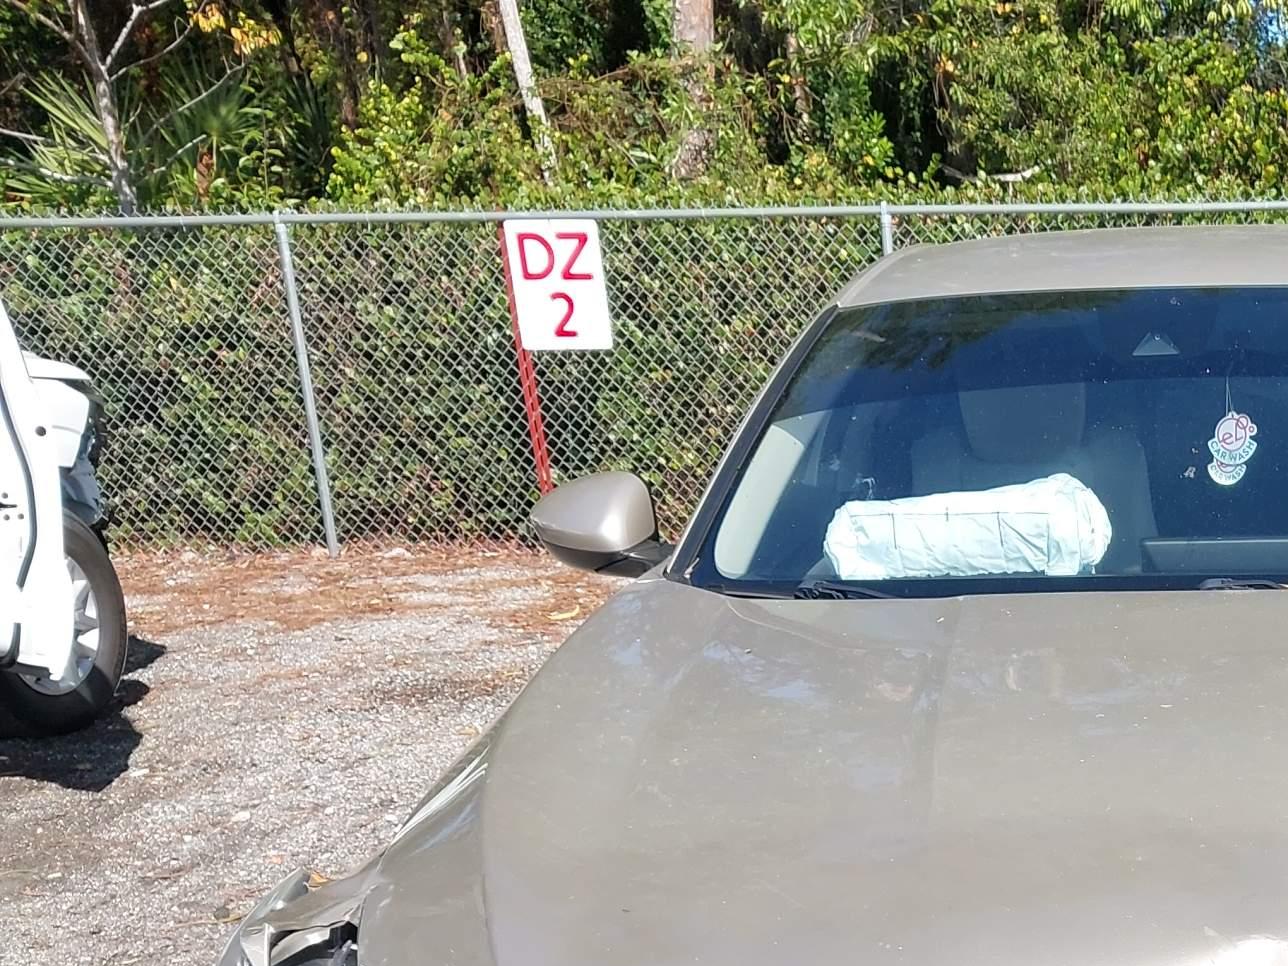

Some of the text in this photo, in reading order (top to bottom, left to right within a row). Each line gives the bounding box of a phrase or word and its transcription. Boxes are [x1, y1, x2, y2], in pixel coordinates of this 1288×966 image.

[516, 232, 594, 280] DZ
[550, 292, 578, 337] 2
[1210, 440, 1255, 461] CAR WASH
